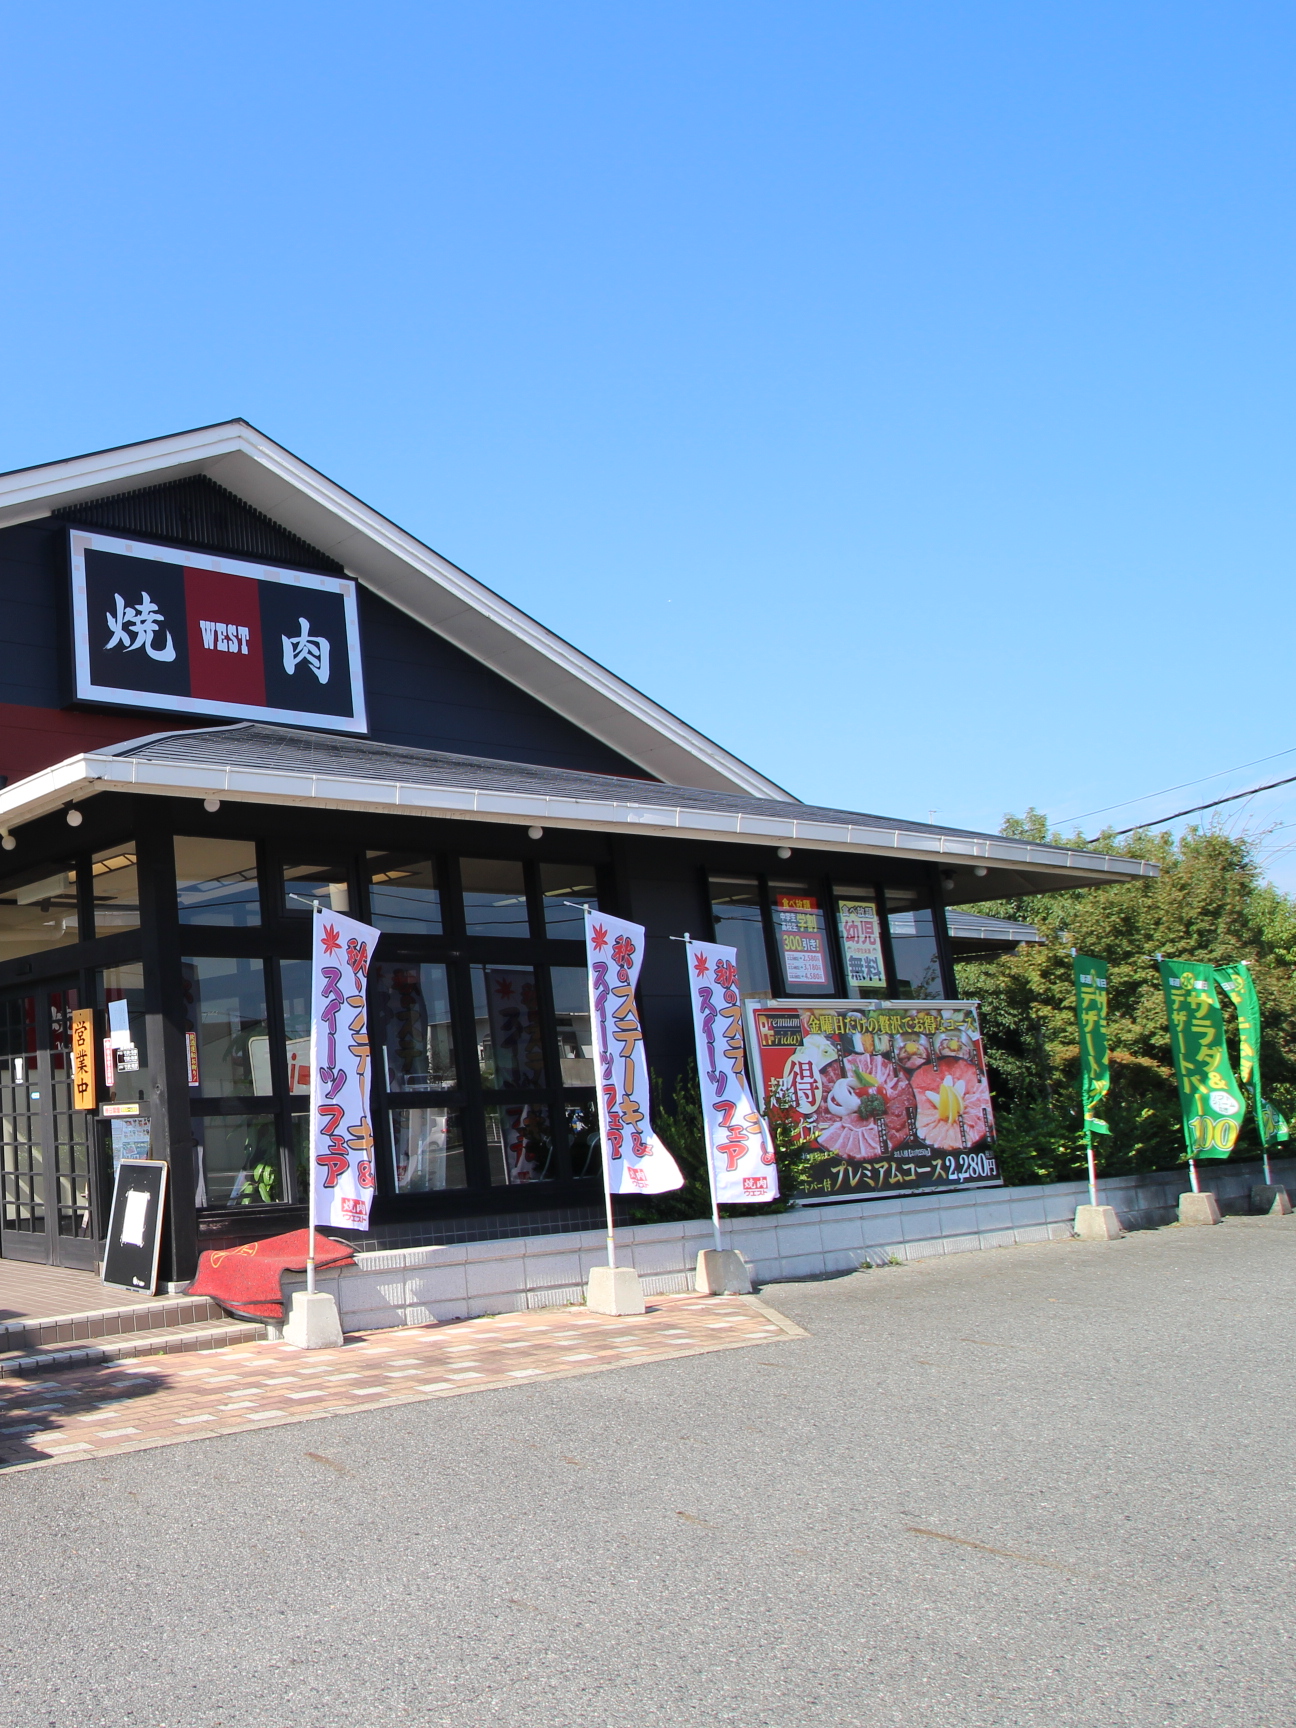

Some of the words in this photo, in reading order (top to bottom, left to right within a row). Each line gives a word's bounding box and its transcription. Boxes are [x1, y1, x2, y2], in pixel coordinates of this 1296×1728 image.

[103, 591, 177, 663] 焼
[199, 620, 250, 655] WEST
[281, 617, 331, 685] 肉
[782, 898, 811, 911] 食べ放題
[841, 904, 874, 918] 食べ放題
[796, 914, 817, 932] 学割
[844, 920, 876, 946] 幼児
[848, 955, 882, 981] 無料
[758, 1015, 800, 1031] Premium
[763, 1030, 801, 1045] Friday
[1186, 991, 1229, 1089] サラダ&
[74, 1021, 90, 1104] 営業中
[1171, 989, 1210, 1115] デザートバー
[831, 1159, 947, 1191] プレミアムコース
[946, 1153, 997, 1182] 2,280円
[744, 1178, 767, 1190] 焼肉
[343, 1199, 367, 1215] 焼肉
